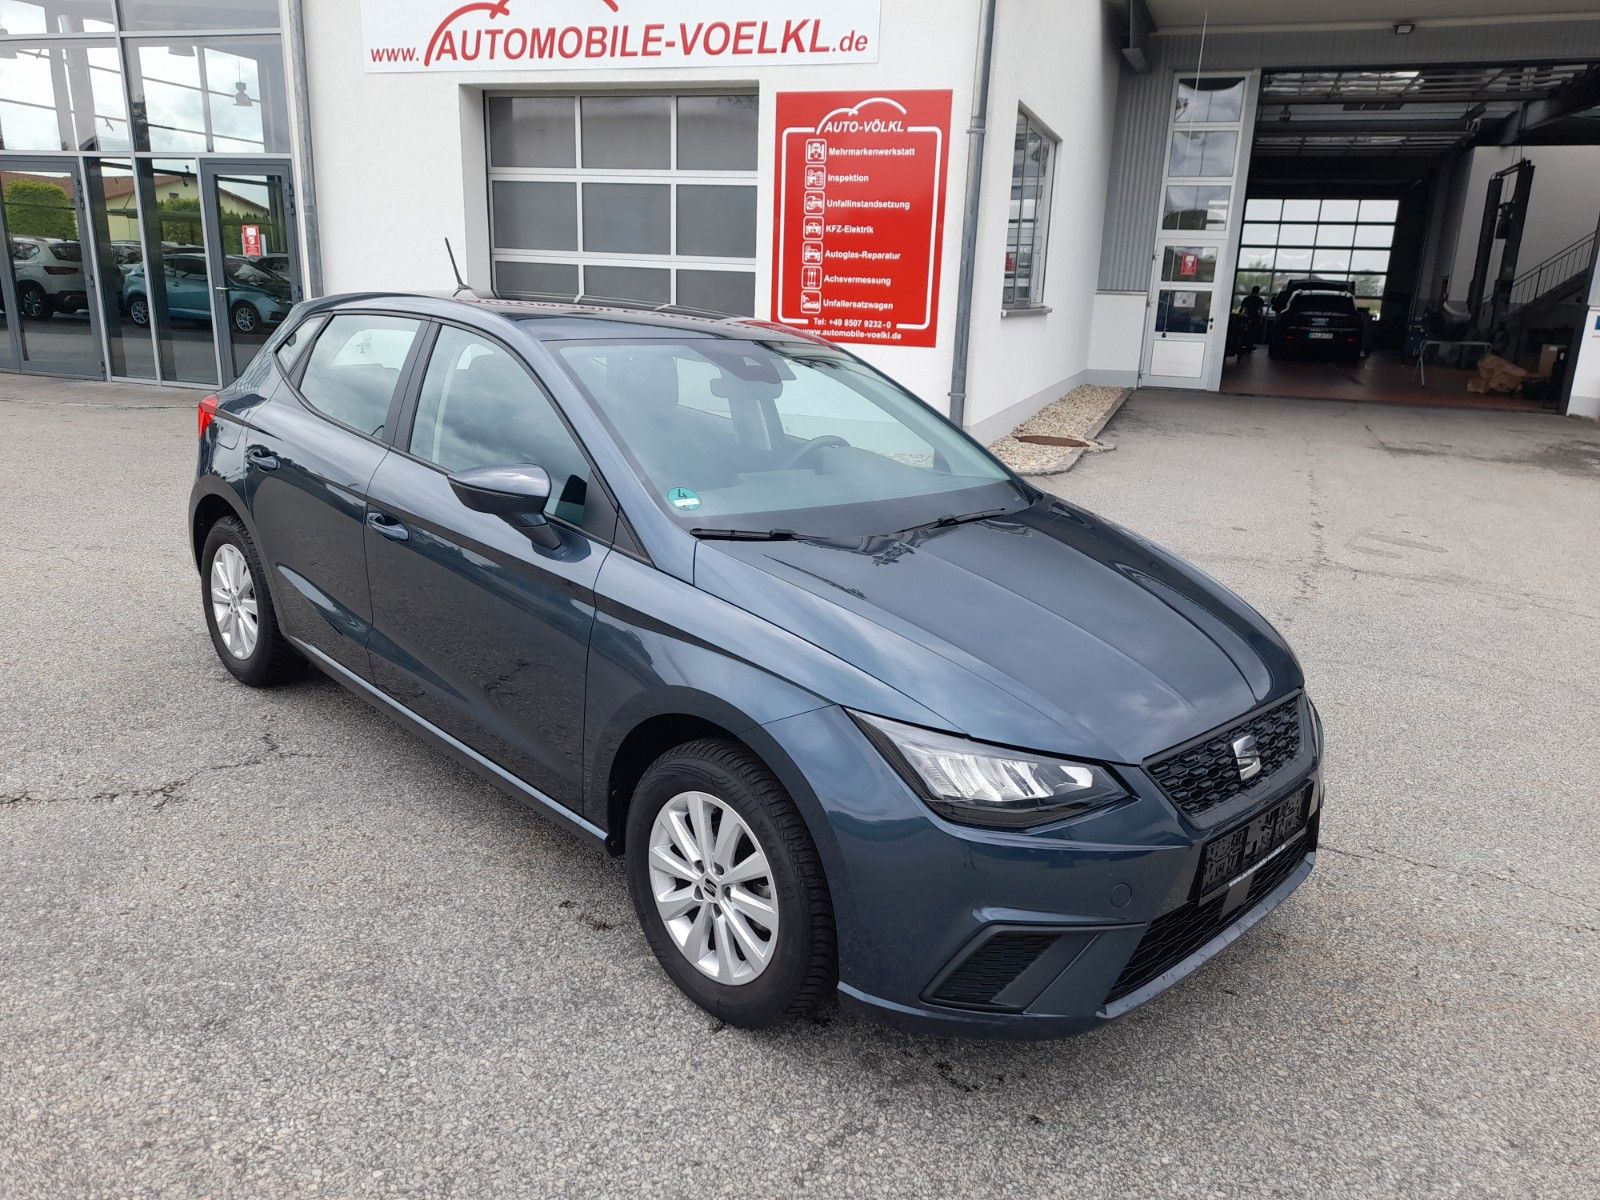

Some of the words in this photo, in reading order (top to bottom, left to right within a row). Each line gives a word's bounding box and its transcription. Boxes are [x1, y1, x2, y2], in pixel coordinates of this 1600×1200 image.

[824, 119, 905, 133] AUTO-VÖLKL
[828, 147, 916, 156] Mehrmarkenwerkstatt
[827, 174, 869, 183] Inspektion
[826, 199, 911, 210] Unfallinstandsetzung
[825, 225, 874, 234] KFZ-Elektrik
[824, 250, 902, 261] Autoglas-Reparatur
[823, 275, 891, 286] Achsvermessung
[823, 300, 893, 310] Unfallersatzwagen
[828, 319, 843, 327] +49
[844, 319, 863, 327] 8507
